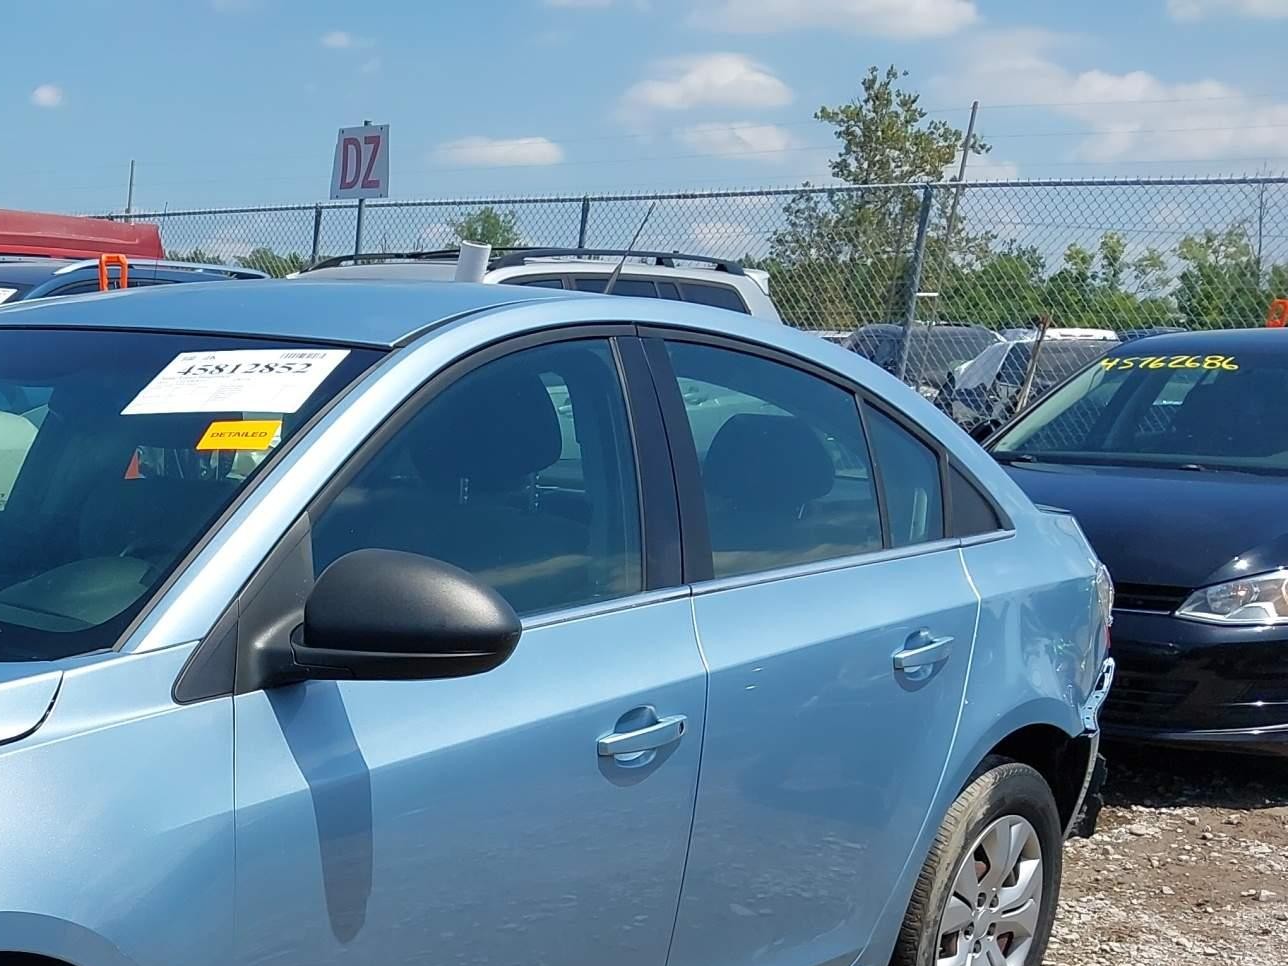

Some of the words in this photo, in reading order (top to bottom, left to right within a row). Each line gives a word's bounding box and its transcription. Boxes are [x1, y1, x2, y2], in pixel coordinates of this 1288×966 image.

[339, 135, 381, 190] DZ
[176, 362, 313, 376] 45812852
[1099, 354, 1240, 371] 45762686
[209, 430, 268, 439] DETAILED
